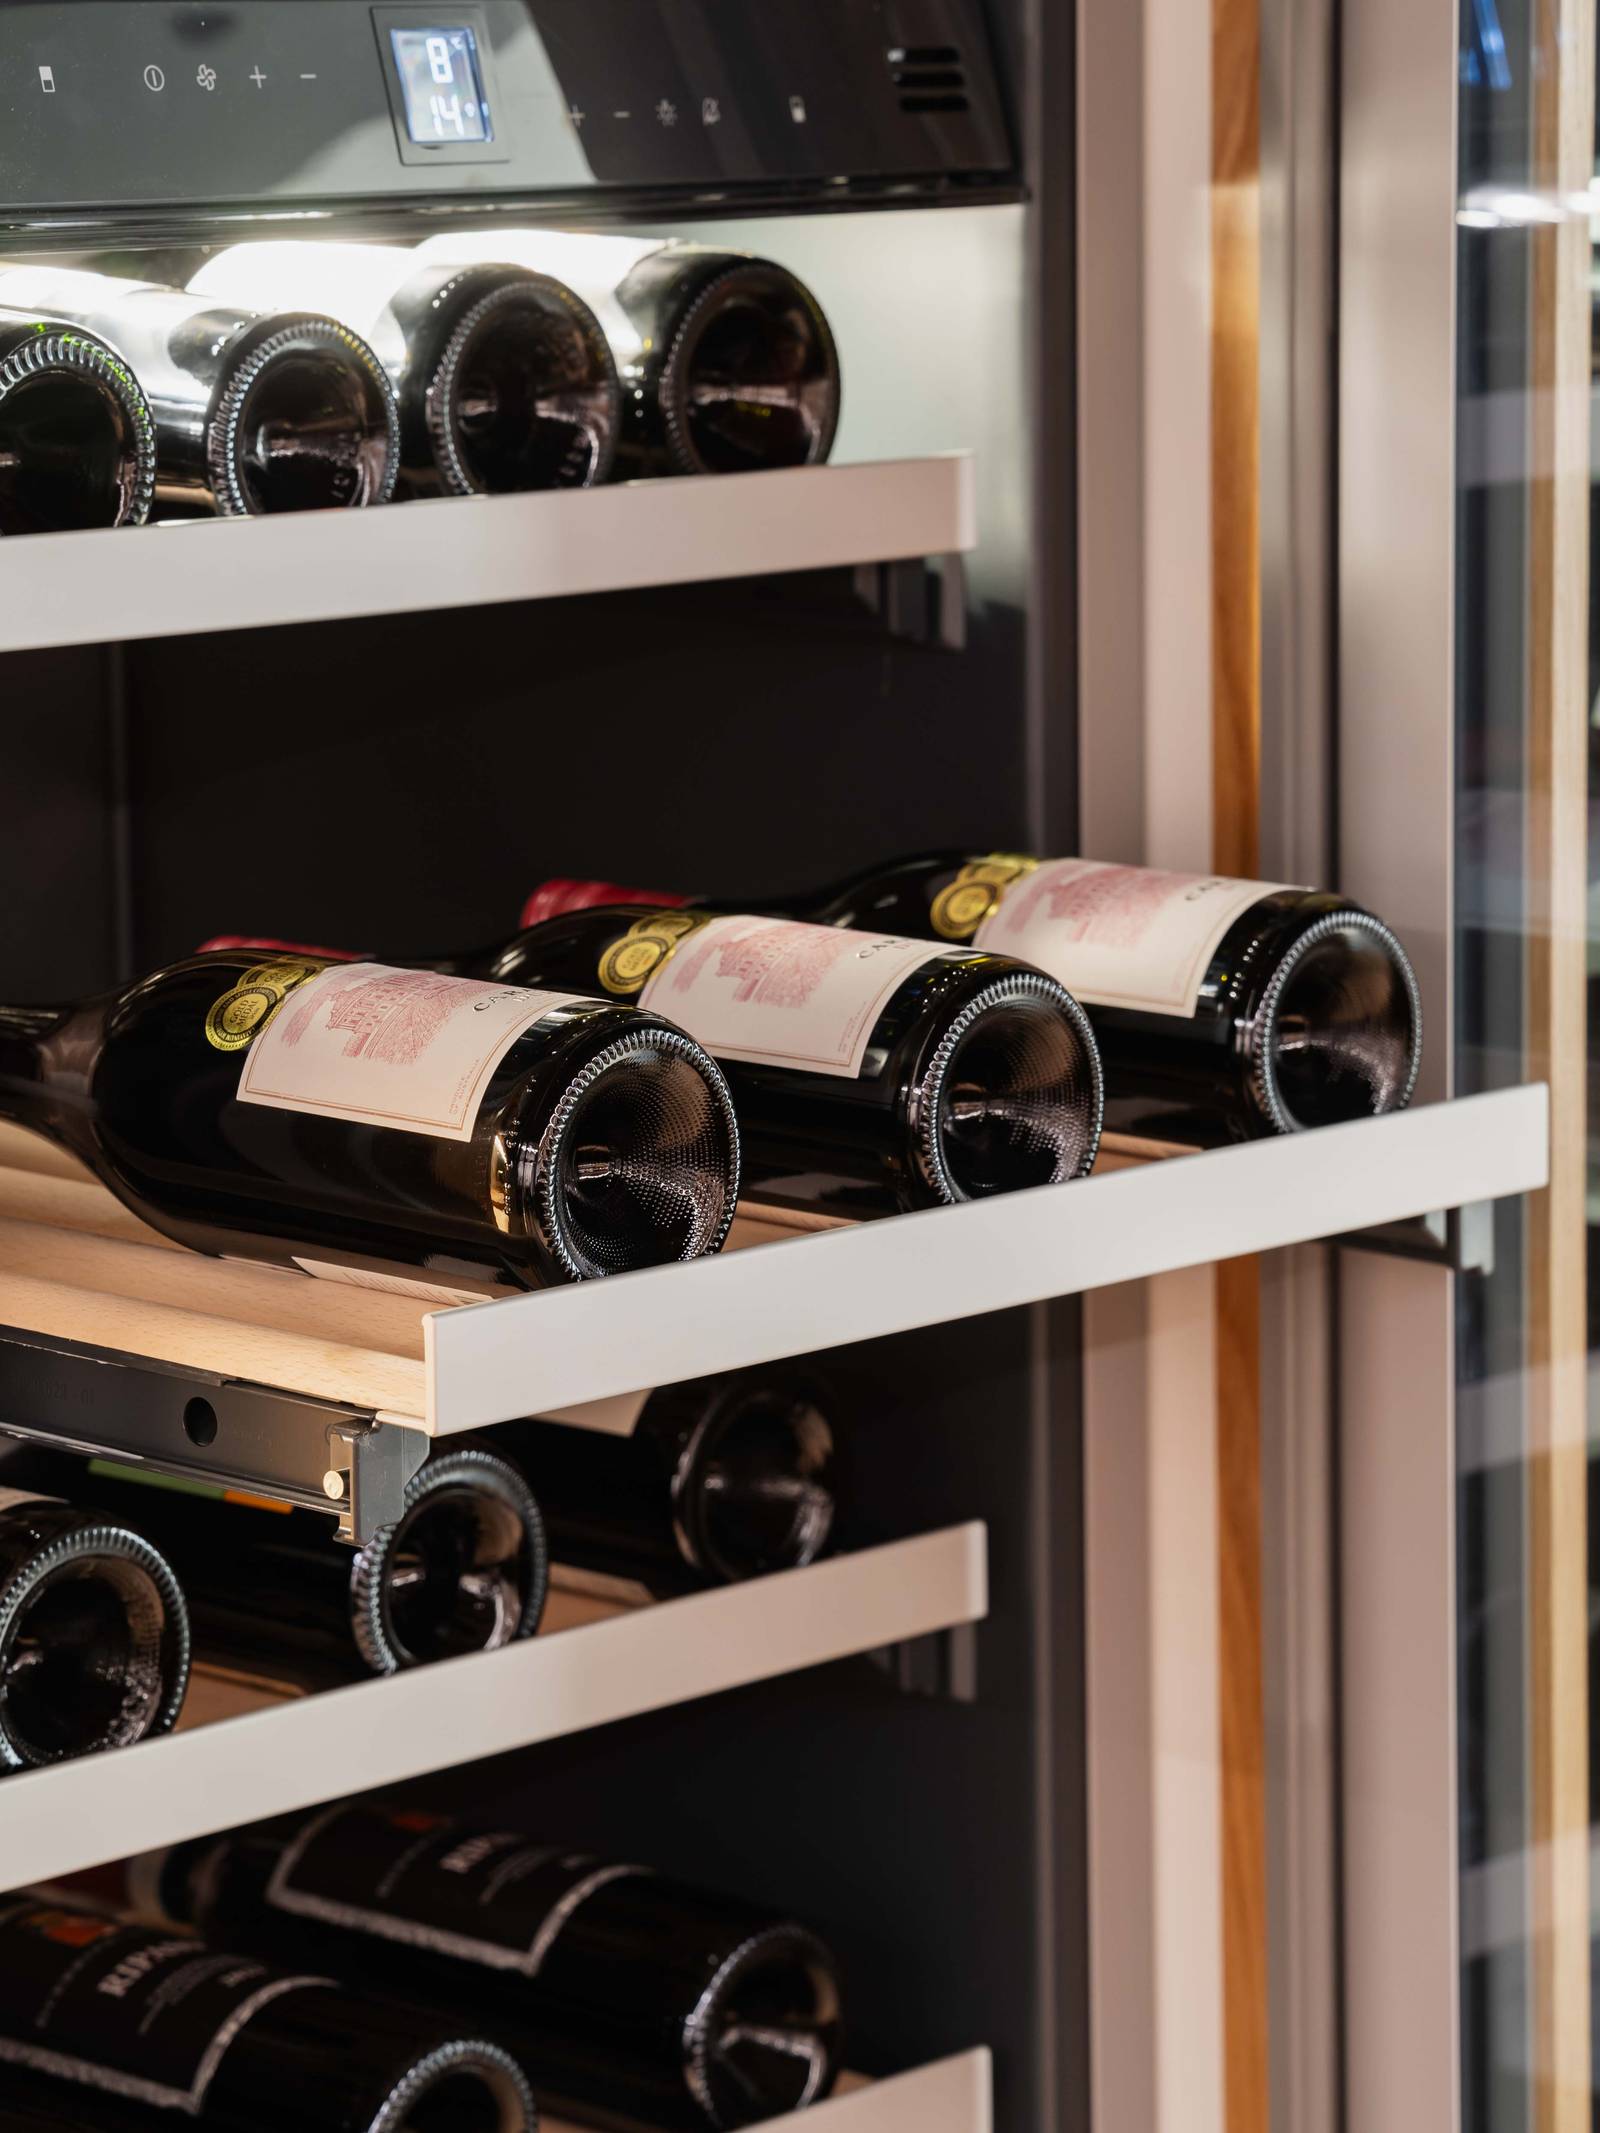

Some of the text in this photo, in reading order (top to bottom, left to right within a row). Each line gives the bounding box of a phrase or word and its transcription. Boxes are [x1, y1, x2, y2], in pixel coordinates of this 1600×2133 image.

[429, 93, 465, 137] 14
[229, 999, 250, 1024] GOLD
[236, 1000, 258, 1026] MEDAL
